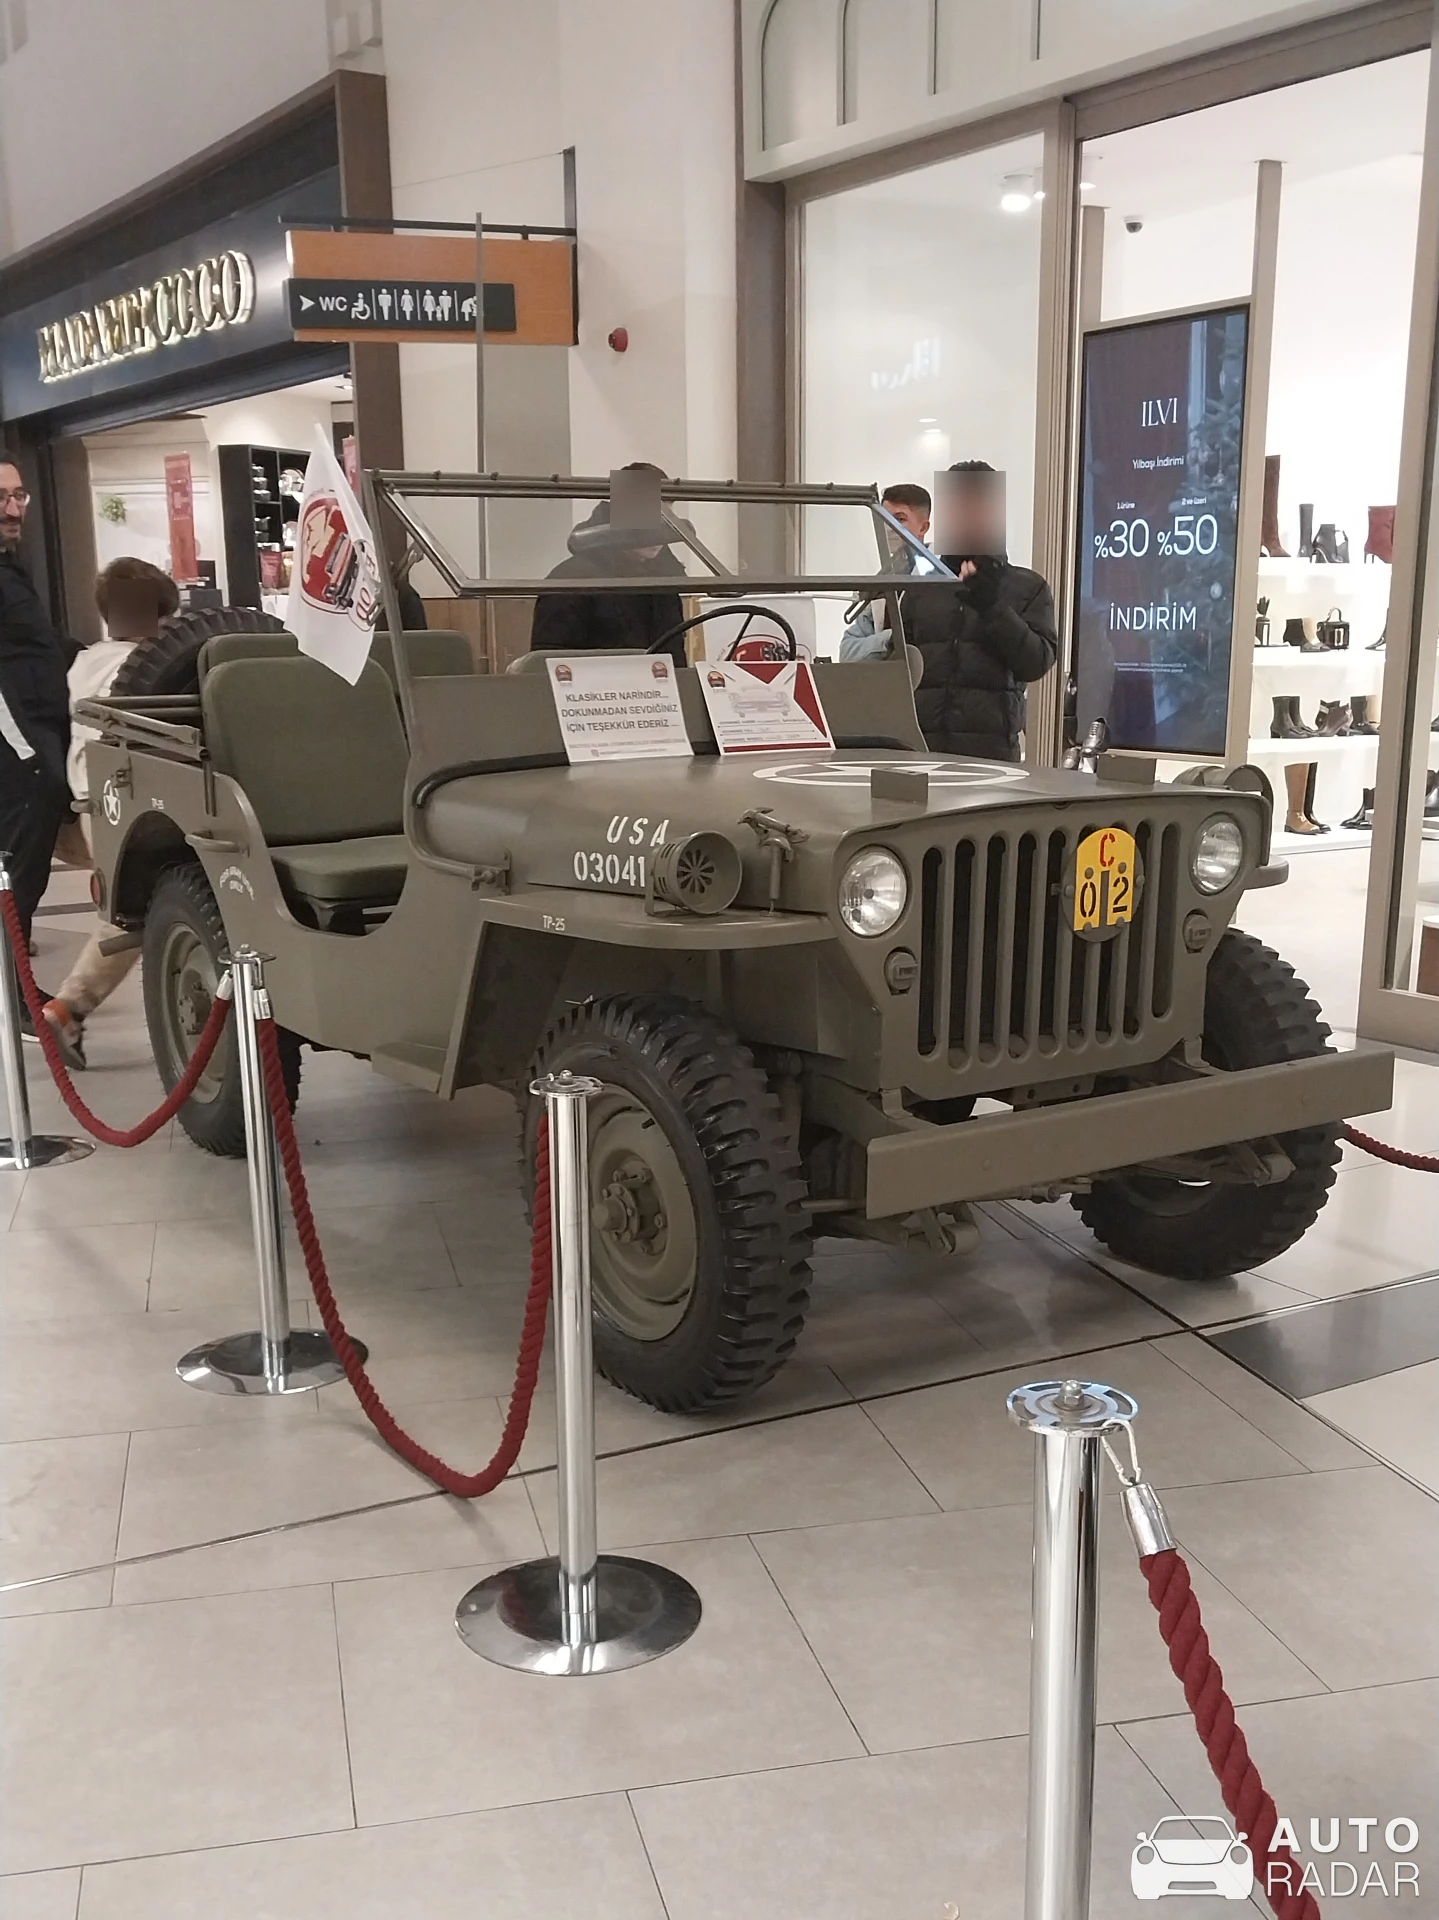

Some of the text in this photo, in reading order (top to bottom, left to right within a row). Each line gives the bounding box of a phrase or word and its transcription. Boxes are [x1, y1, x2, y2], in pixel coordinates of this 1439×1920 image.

[319, 296, 347, 312] WC
[1141, 398, 1178, 427] ILVI
[1094, 514, 1218, 558] %30 %50
[1110, 601, 1197, 631] İNDİRİM
[561, 704, 679, 718] DOKUNMADAN SEVDİĞİNİZ
[565, 691, 617, 702] KLASİKLER
[566, 722, 585, 733] İÇİN
[587, 719, 635, 732] TEŞEKKÜR
[637, 718, 670, 729] EDERİZ
[606, 815, 670, 847] USA
[1100, 832, 1116, 867] C
[573, 851, 646, 888] 03041
[543, 914, 566, 931] TP-25
